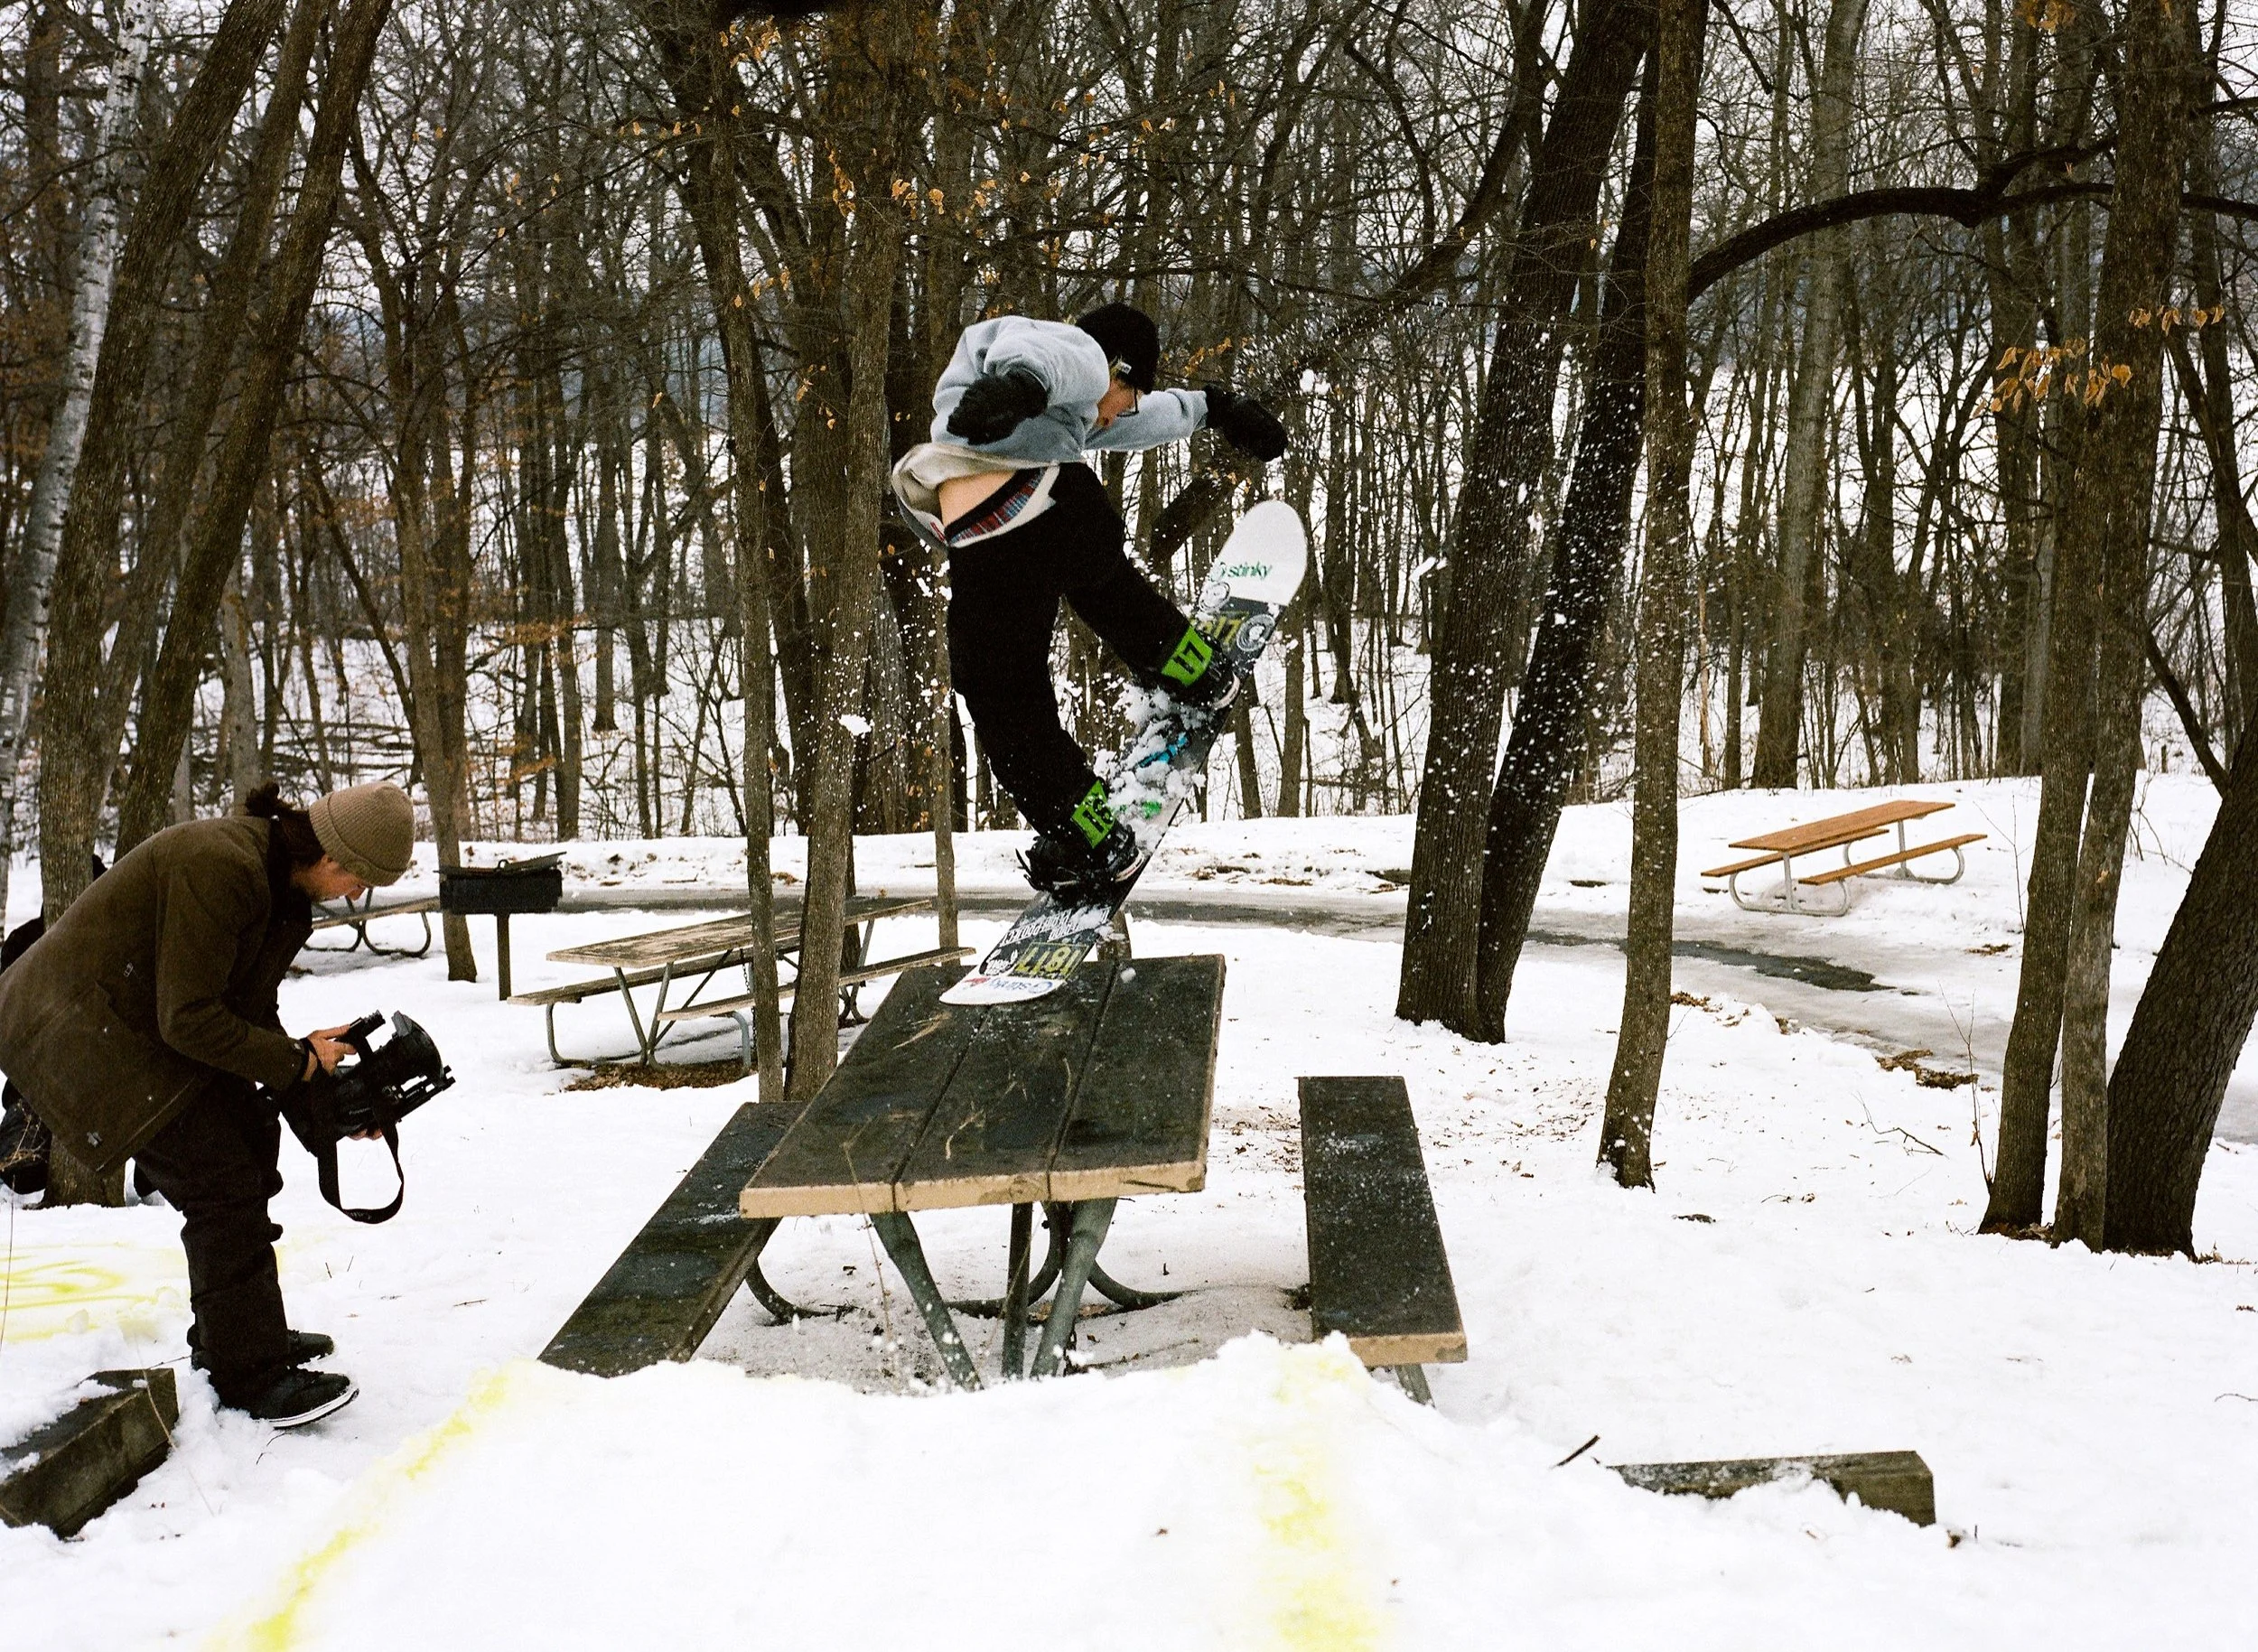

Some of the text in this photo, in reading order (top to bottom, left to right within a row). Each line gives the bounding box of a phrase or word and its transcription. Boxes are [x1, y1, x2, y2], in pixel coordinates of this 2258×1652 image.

[1227, 562, 1272, 580] stinky
[1174, 641, 1204, 675] 17
[1013, 947, 1080, 976] 1817
